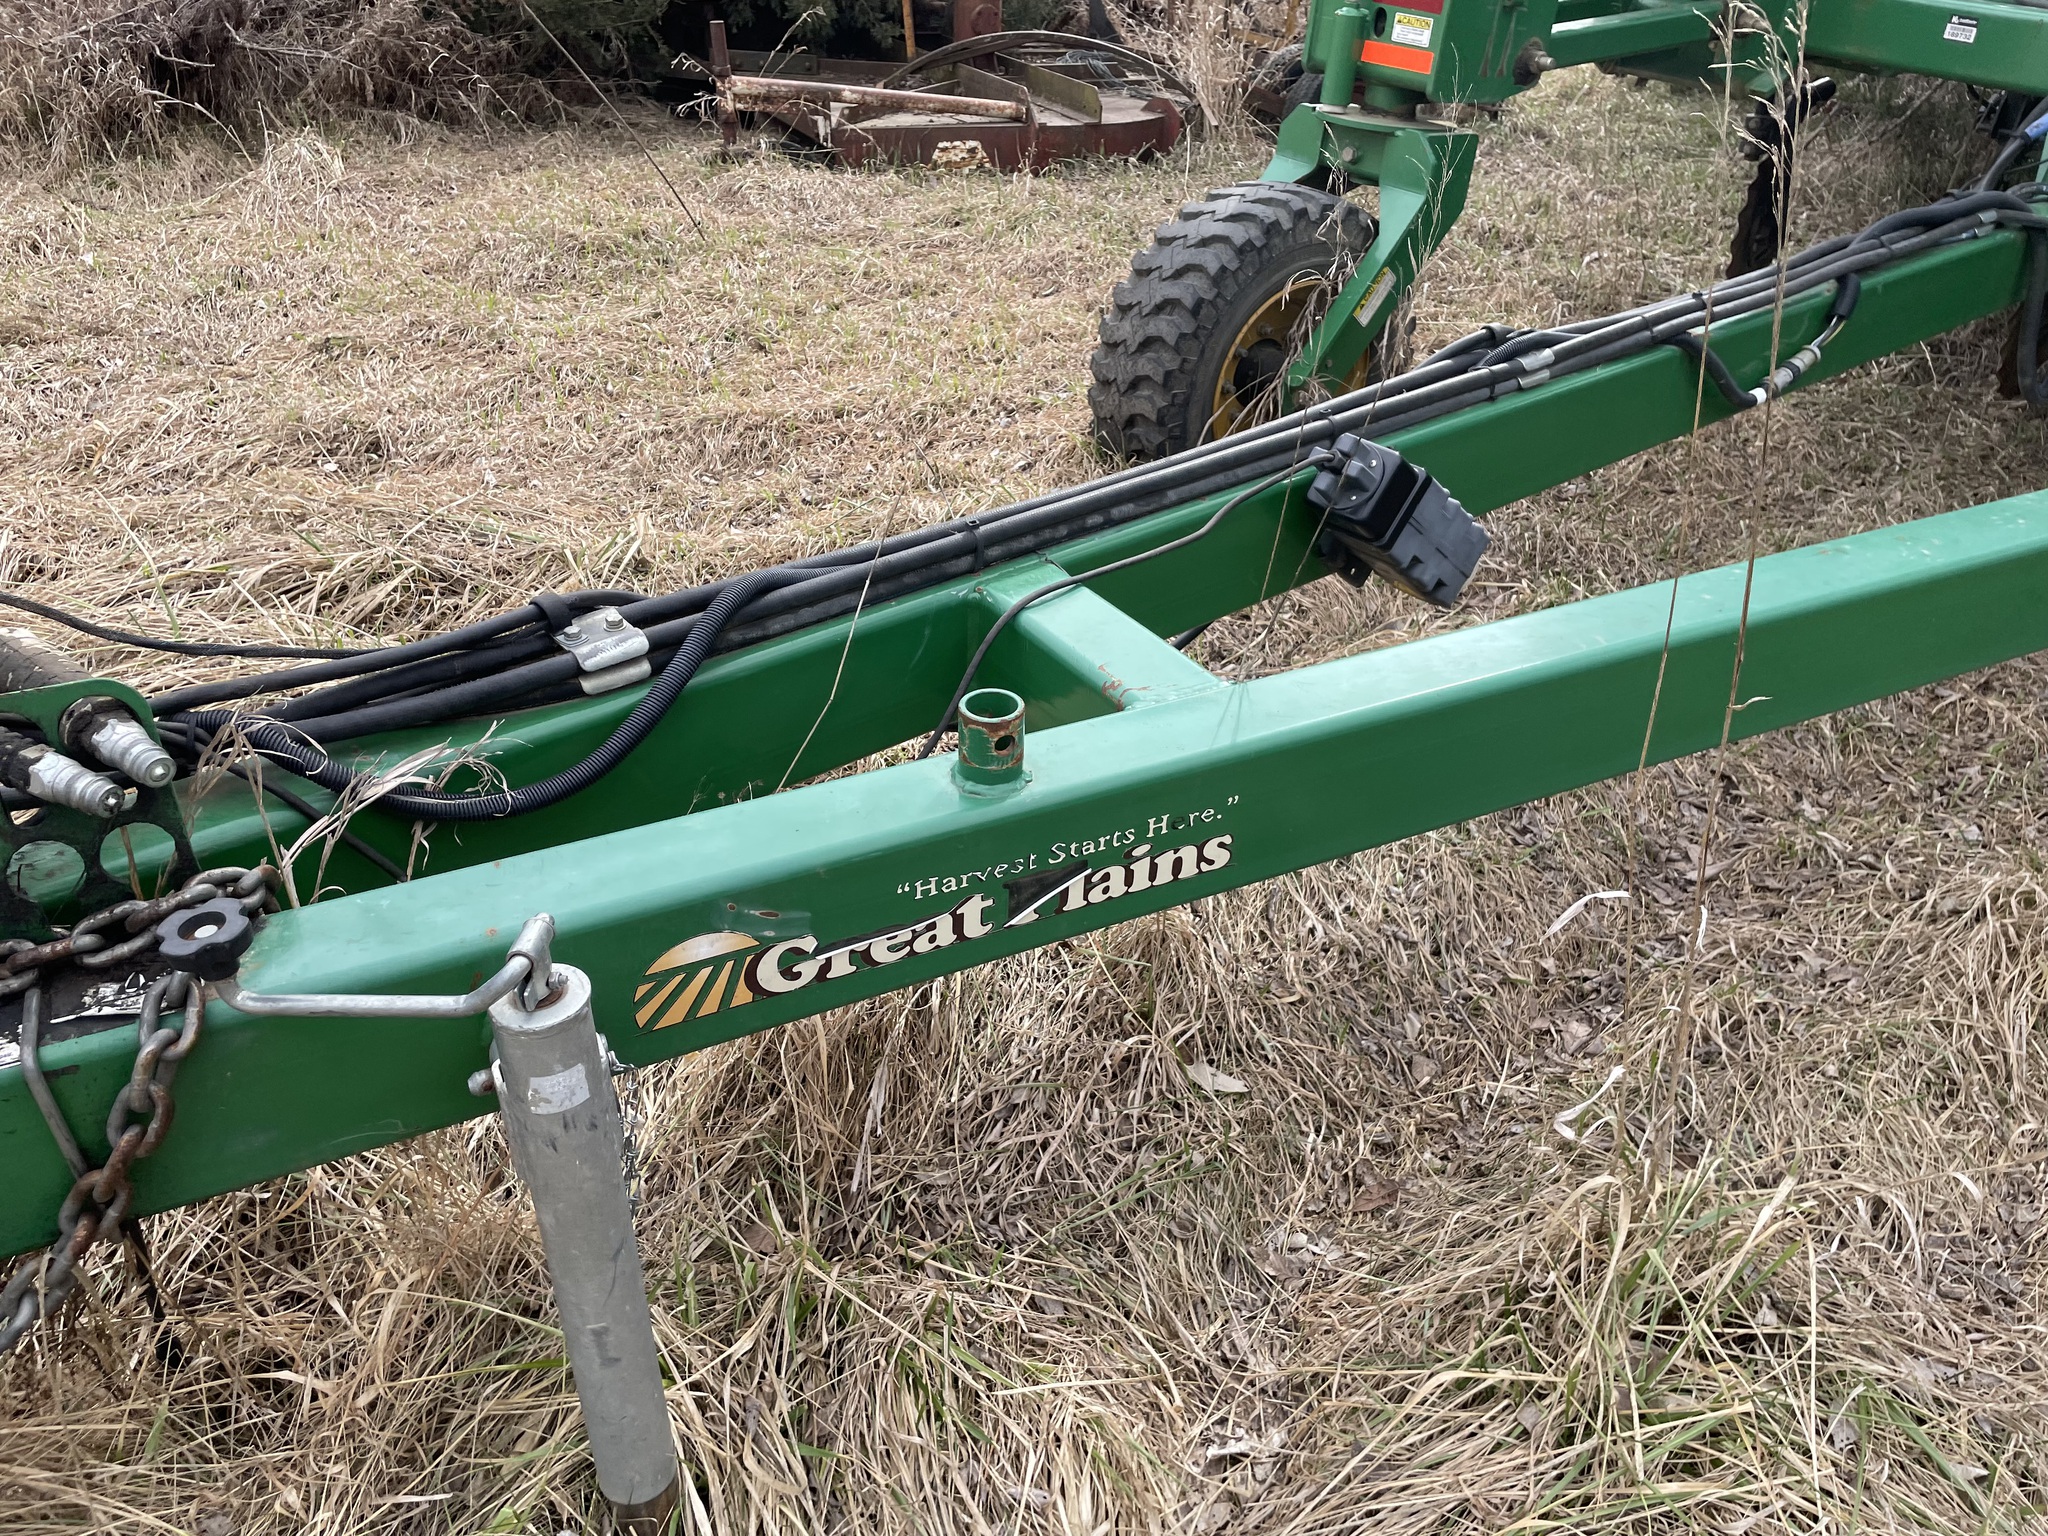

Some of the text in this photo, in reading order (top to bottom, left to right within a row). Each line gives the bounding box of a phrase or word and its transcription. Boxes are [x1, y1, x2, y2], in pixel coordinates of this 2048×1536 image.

[1402, 16, 1431, 29] CAUTION
[1048, 827, 1136, 863] Starts
[751, 834, 1235, 996] Great lains
